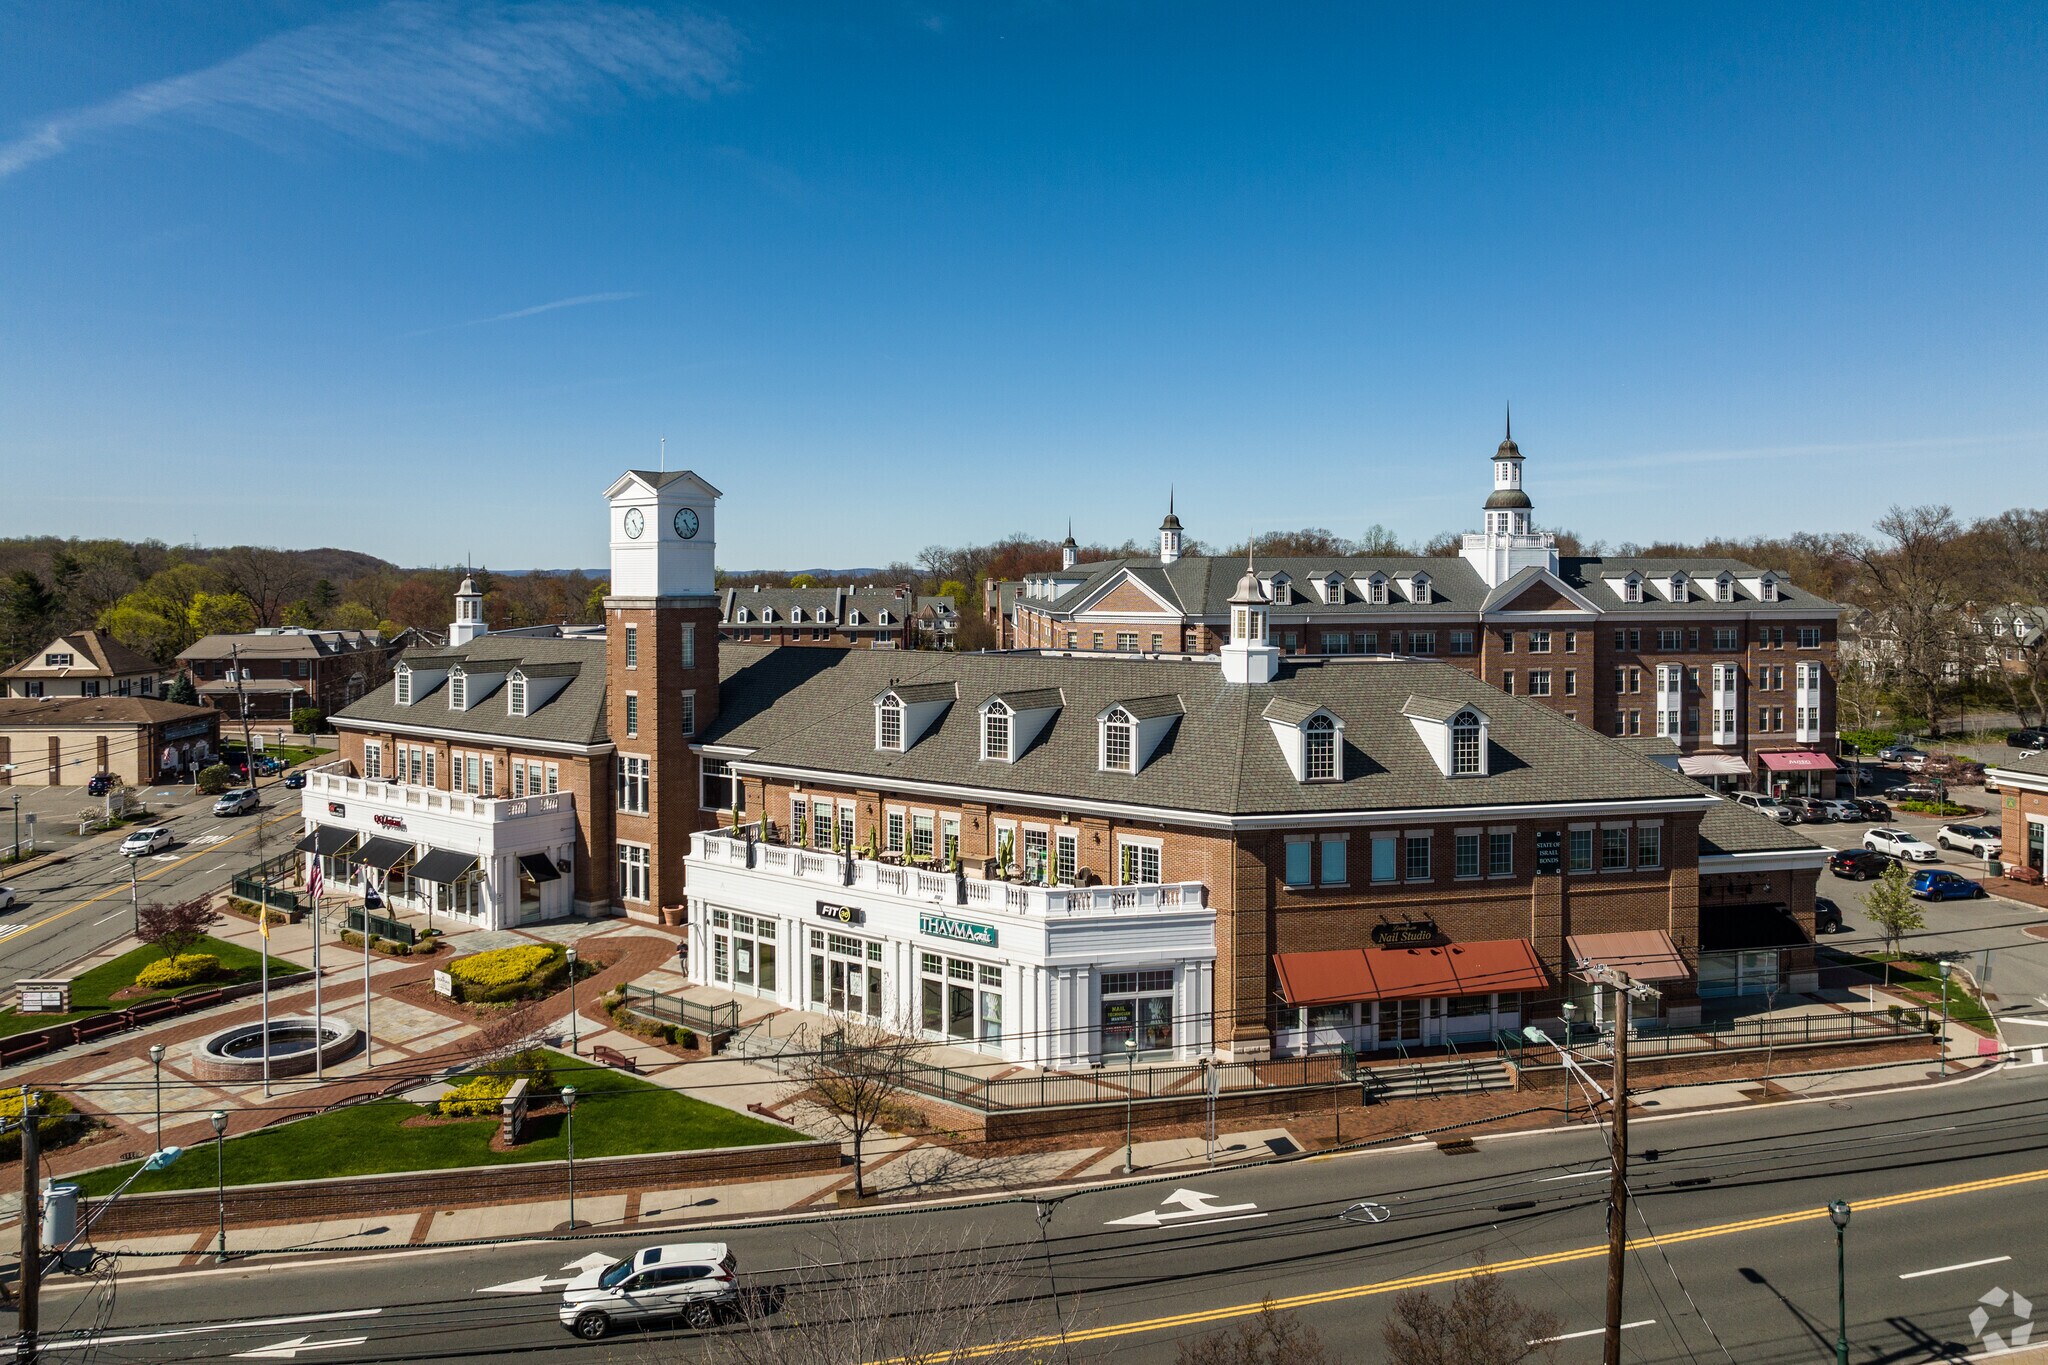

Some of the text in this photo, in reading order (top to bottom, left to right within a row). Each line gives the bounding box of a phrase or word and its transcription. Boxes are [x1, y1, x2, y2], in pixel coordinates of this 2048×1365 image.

[822, 905, 840, 917] FIT
[1379, 930, 1431, 942] Nail Studio
